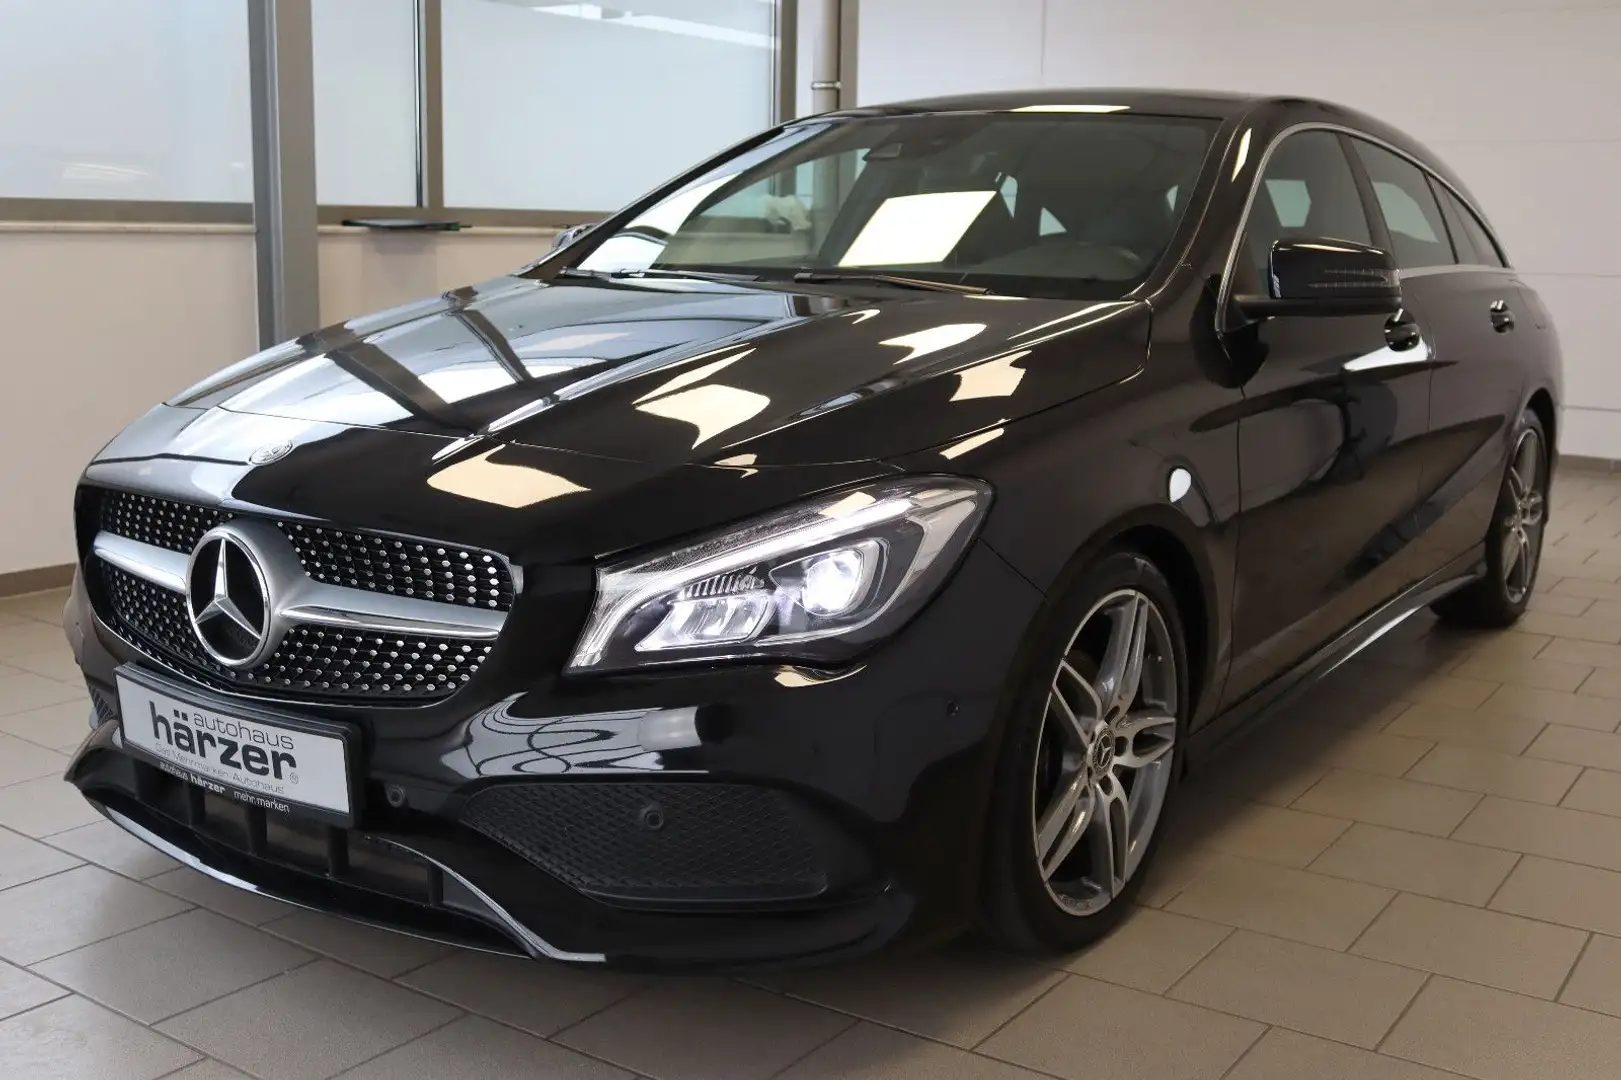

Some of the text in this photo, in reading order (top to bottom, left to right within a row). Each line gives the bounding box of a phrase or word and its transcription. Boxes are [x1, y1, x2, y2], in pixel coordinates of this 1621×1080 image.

[149, 700, 297, 780] härzer
[193, 713, 294, 750] autohaus
[190, 773, 226, 794] härzer
